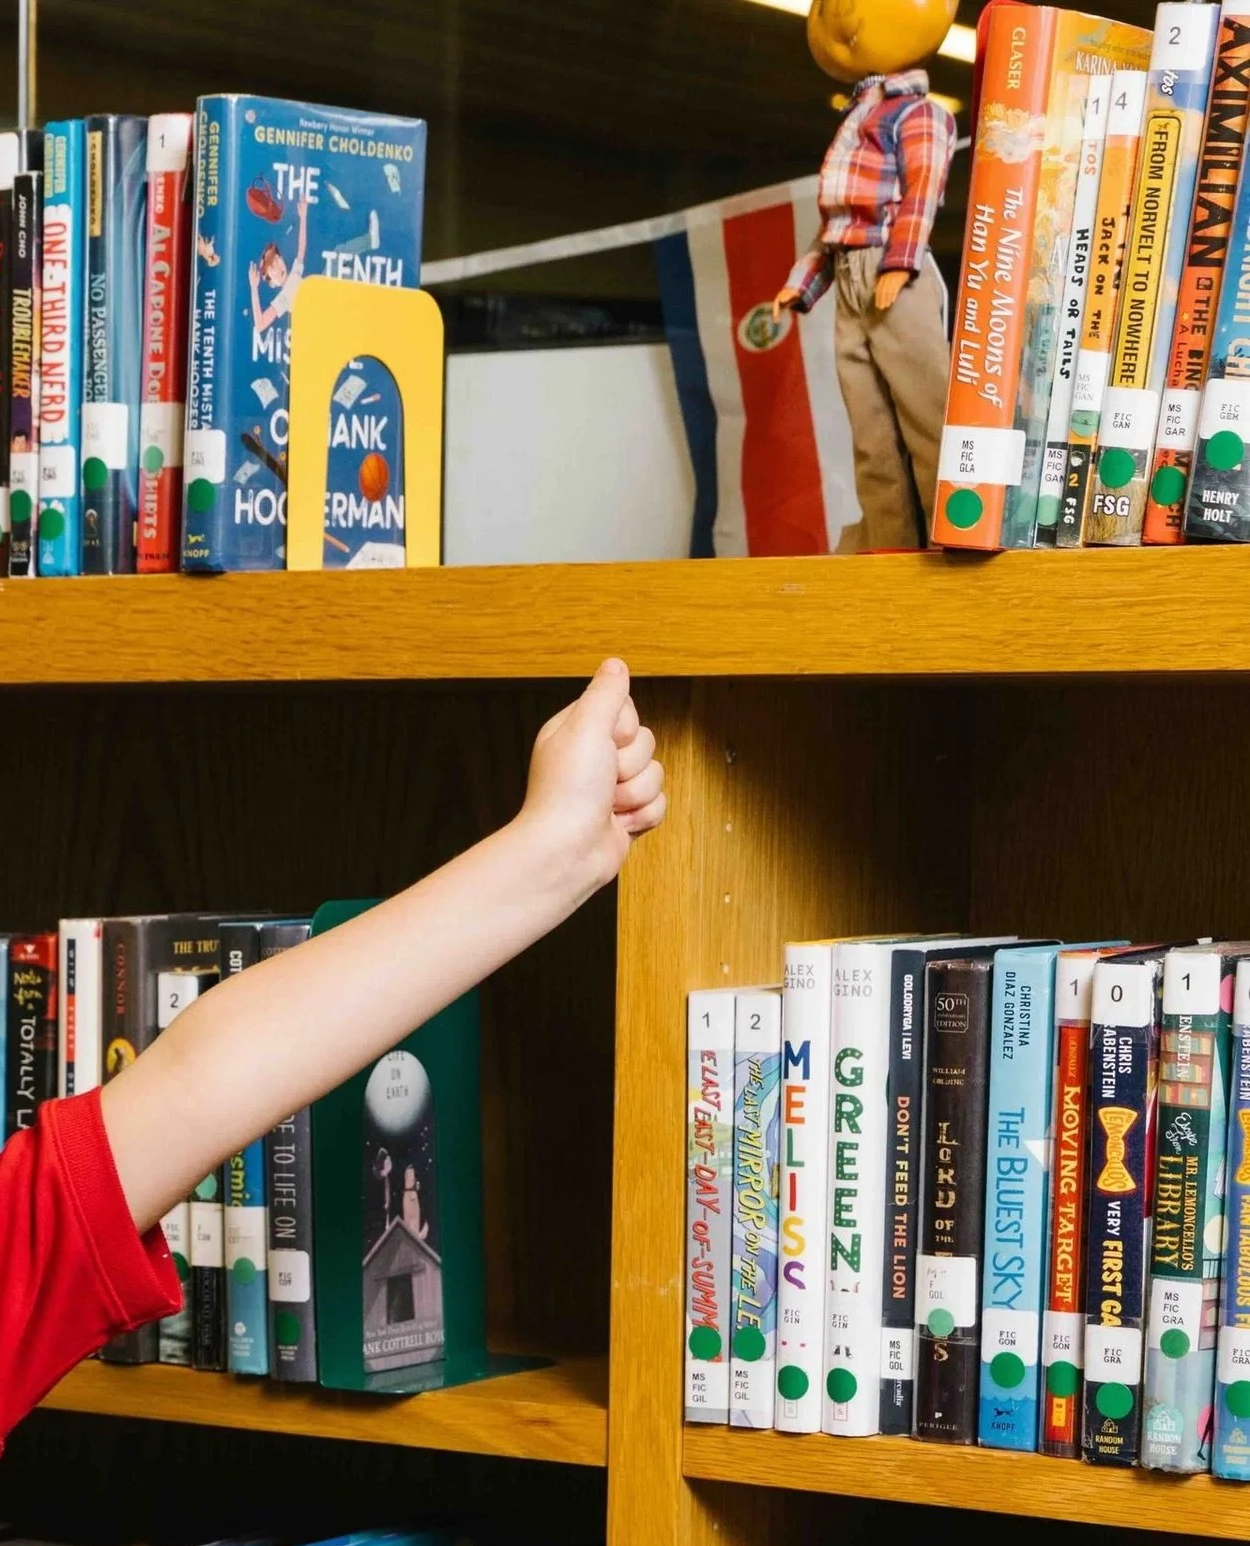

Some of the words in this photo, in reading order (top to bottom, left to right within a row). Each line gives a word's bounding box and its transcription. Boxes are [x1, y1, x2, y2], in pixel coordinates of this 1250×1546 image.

[1168, 26, 1181, 45] 2
[1007, 27, 1026, 89] GLASER
[254, 126, 324, 150] GENNIFER
[328, 135, 413, 162] CHOLDENKO
[1149, 131, 1169, 179] FROM
[207, 121, 220, 207] GENNIFER
[272, 162, 321, 205] THE
[1003, 187, 1023, 221] The
[152, 224, 171, 255] AL
[971, 204, 995, 253] Han
[1098, 217, 1115, 265] JACK
[1137, 187, 1162, 265] NORVELT
[18, 233, 26, 259] CHO
[994, 226, 1023, 282] Nine
[1071, 228, 1090, 287] HEADS
[321, 250, 403, 288] TENTH
[966, 260, 990, 291] Yu
[1095, 274, 1106, 295] ON
[1133, 271, 1150, 293] TO
[964, 298, 982, 335] and
[1066, 298, 1079, 318] OR
[1088, 310, 1101, 338] THE
[1190, 297, 1210, 336] THE
[12, 287, 32, 399] TROUBLEMAKER
[985, 289, 1014, 377] Moons
[1119, 299, 1145, 384] NOWHERE
[956, 339, 981, 386] Luli
[1059, 328, 1076, 380] TAILS
[41, 362, 66, 423] NERD
[977, 383, 1002, 409] of
[1168, 404, 1182, 412] MS
[1166, 415, 1181, 424] FIC
[961, 452, 974, 462] FIC
[962, 440, 975, 450] MS
[1093, 495, 1130, 516] FSG
[1202, 490, 1240, 506] HENRY
[1203, 506, 1234, 523] HOLT
[173, 940, 195, 954] THE
[116, 943, 126, 1016] CONNOR
[784, 964, 815, 977] ALEX
[784, 977, 816, 990] GINO
[1181, 973, 1191, 991] 1
[902, 973, 913, 1032] GOLODRYGA
[1111, 984, 1123, 1003] 0
[701, 1011, 711, 1029] 1
[750, 1013, 762, 1031] 2
[1002, 1002, 1015, 1060] GONZALEZ
[1018, 985, 1031, 1047] CHRISTINA
[16, 1016, 36, 1101] TOTALLY
[1119, 1037, 1133, 1075] CHRIS
[896, 1095, 910, 1154] DON'T
[997, 1107, 1025, 1149] THE
[1060, 1085, 1081, 1194] MOVING
[273, 1143, 296, 1165] TO
[831, 1047, 864, 1273] GREEN
[273, 1173, 296, 1208] LIFE
[737, 1126, 766, 1230] MIRROR
[894, 1160, 909, 1207] FEED
[994, 1156, 1029, 1249] BLUEST
[1107, 1200, 1121, 1237] VERY
[1154, 1156, 1184, 1269] LIBRARY
[274, 1216, 297, 1239] ON
[893, 1213, 908, 1248] THE
[1181, 1181, 1198, 1272] LEMONCELLO'S
[1055, 1202, 1077, 1304] TARGET
[1101, 1240, 1124, 1297] FIRST
[740, 1258, 756, 1294] THE
[892, 1254, 907, 1300] LION
[991, 1254, 1025, 1310] SKY
[735, 1370, 749, 1379] MS
[735, 1381, 749, 1390] FIC
[1095, 1434, 1124, 1446] RANDOM
